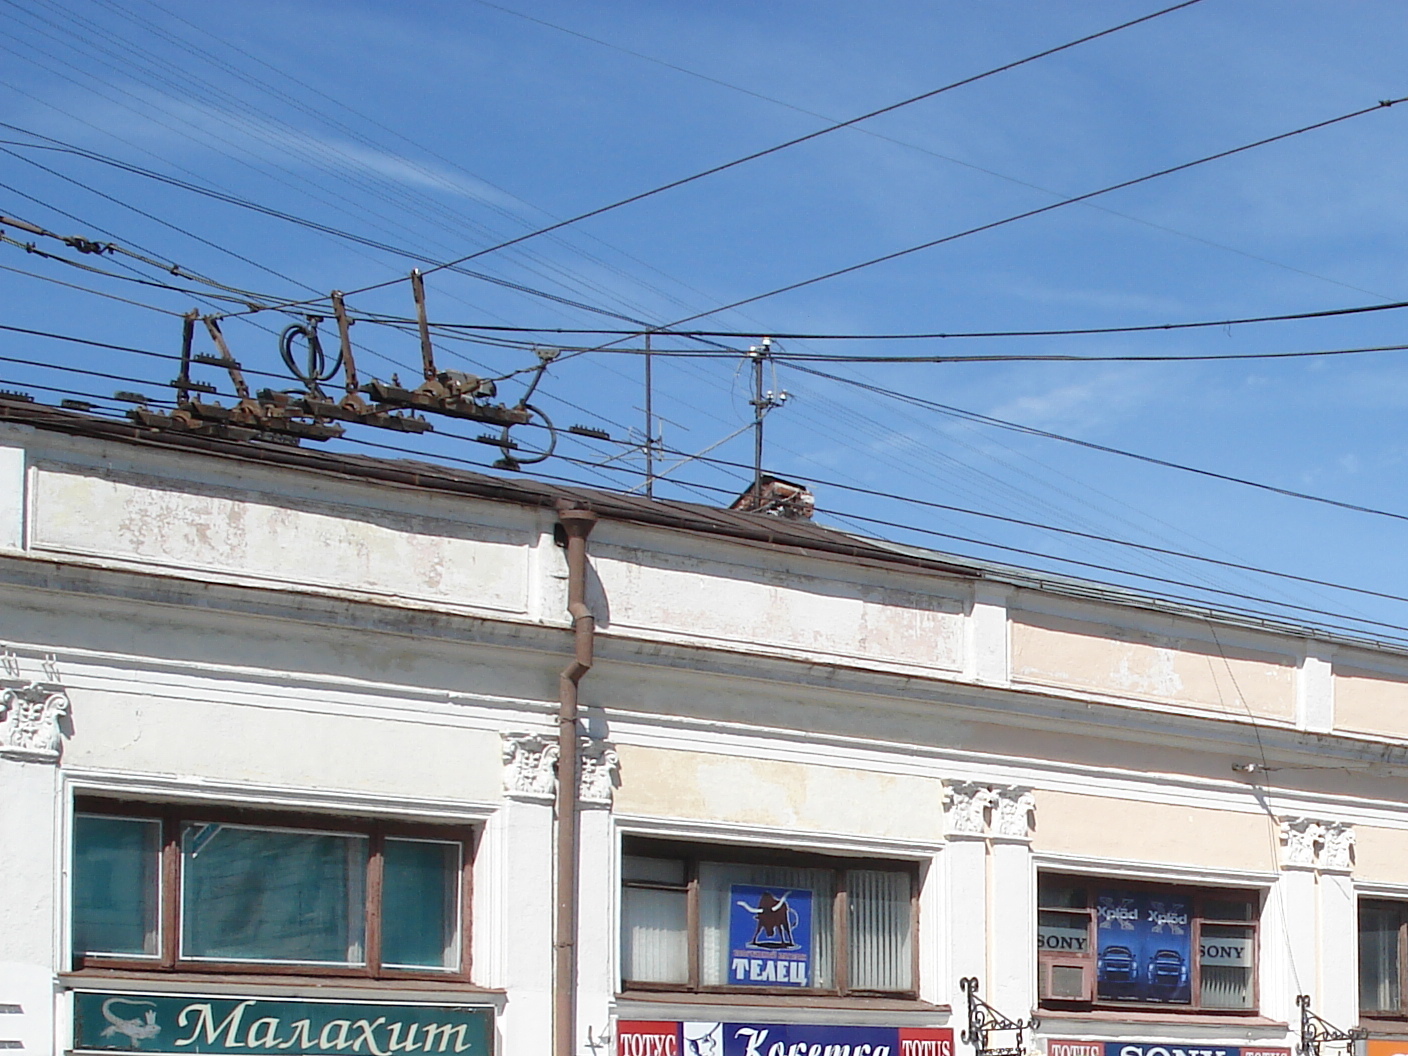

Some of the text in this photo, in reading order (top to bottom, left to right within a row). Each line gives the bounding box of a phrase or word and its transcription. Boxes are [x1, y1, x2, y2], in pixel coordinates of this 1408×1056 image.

[1038, 935, 1087, 950] SONY
[1200, 944, 1245, 958] SONY
[732, 958, 807, 986] ТЕЛЕЦ
